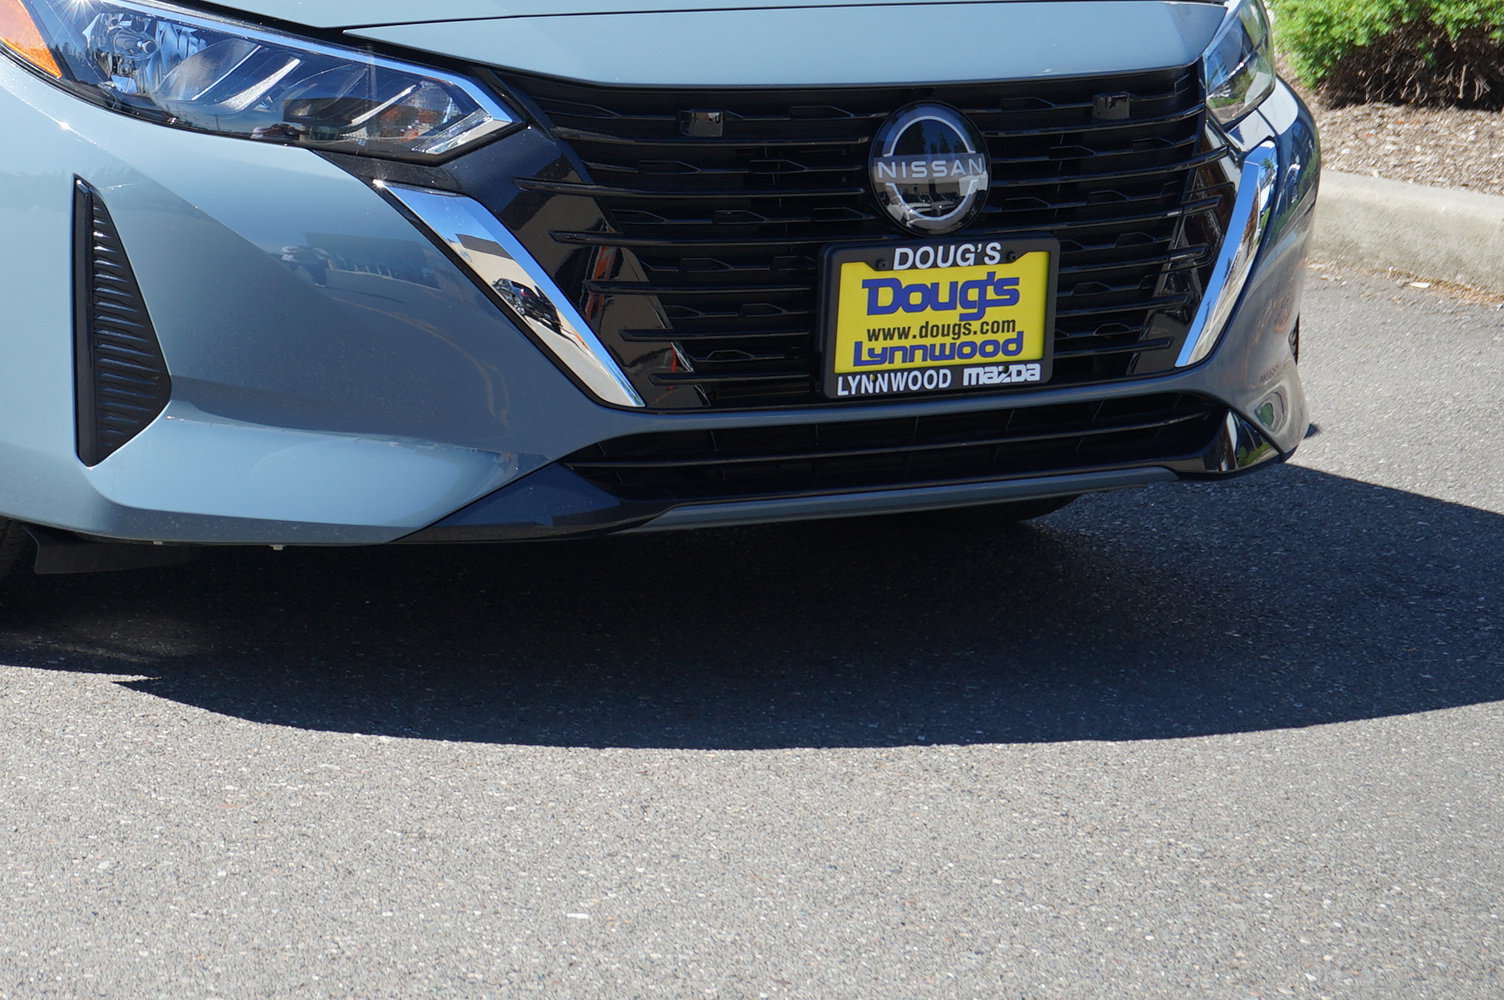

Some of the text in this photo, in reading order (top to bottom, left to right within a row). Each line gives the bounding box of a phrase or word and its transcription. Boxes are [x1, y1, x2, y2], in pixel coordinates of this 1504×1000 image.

[878, 157, 983, 179] NISSAN
[893, 242, 1002, 270] DOUG'S
[862, 271, 1020, 321] Doug's
[867, 318, 1017, 341] www.dougs.com
[853, 331, 1024, 367] Lynnwood
[837, 369, 952, 396] LYNNWOOD
